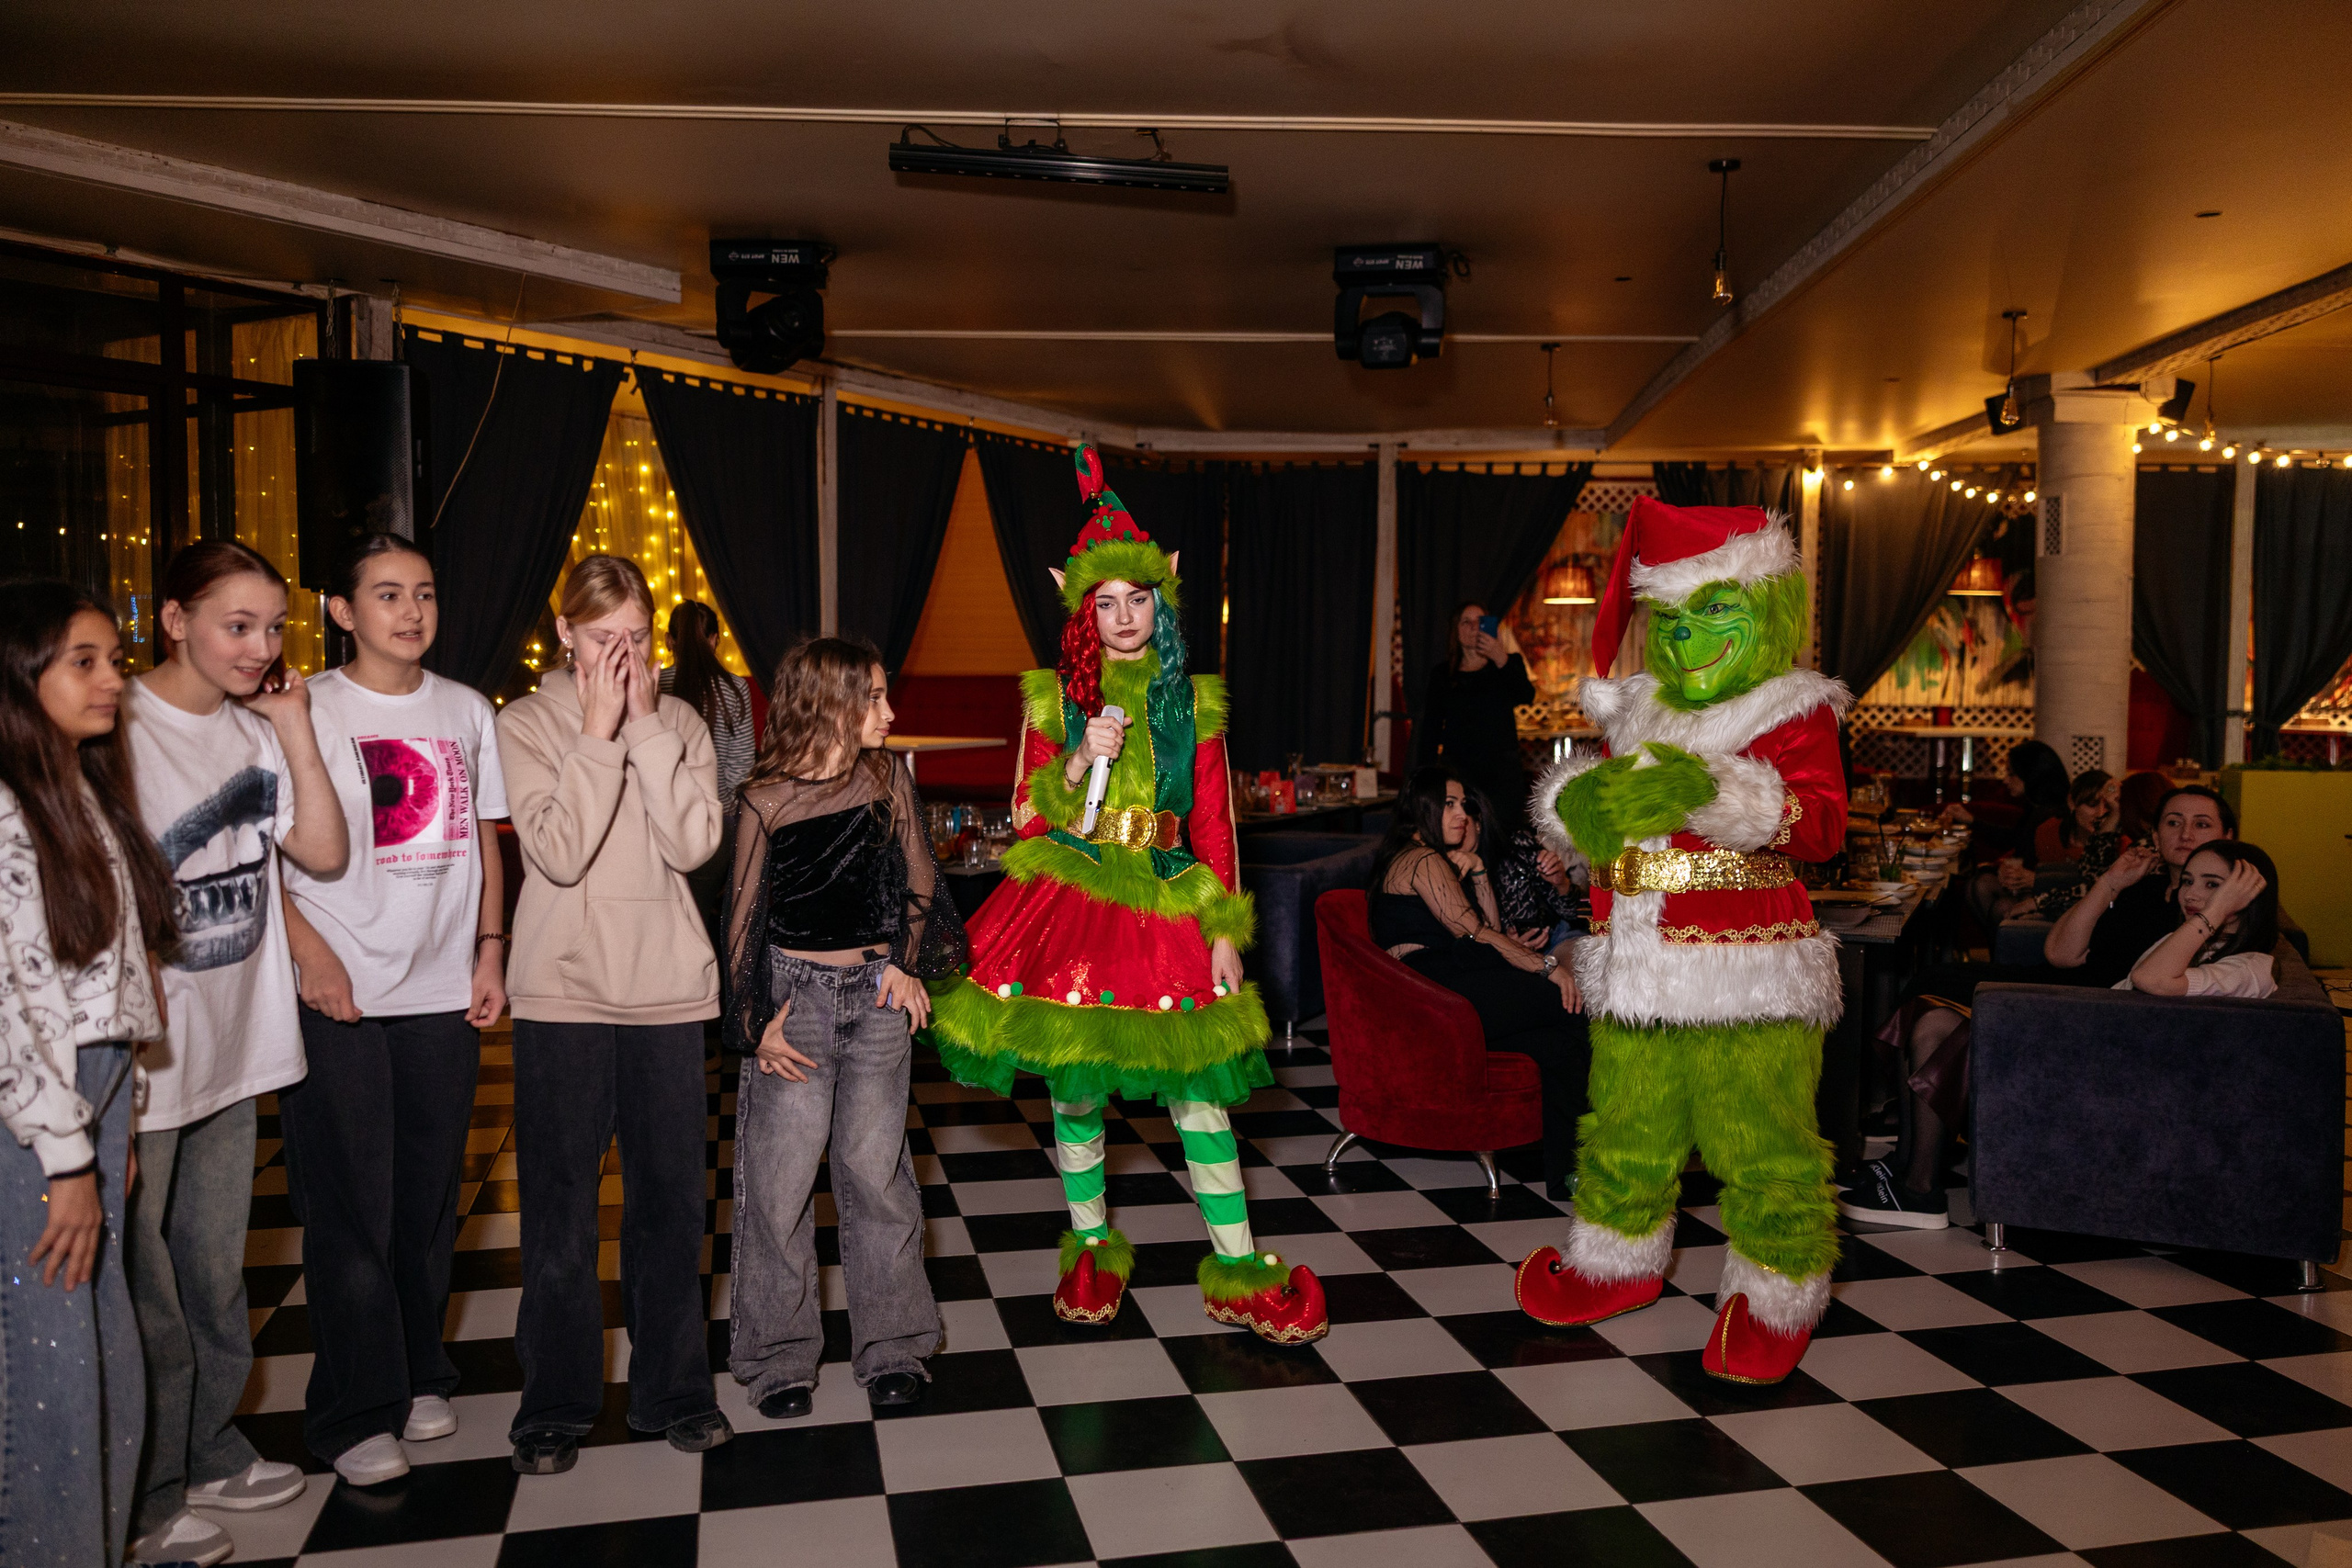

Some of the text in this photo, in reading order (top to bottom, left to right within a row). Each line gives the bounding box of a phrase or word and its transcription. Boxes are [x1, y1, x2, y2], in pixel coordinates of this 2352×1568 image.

[771, 254, 800, 264] WEN
[1395, 260, 1424, 270] WEN
[449, 740, 464, 766] MOON
[444, 757, 454, 776] Times
[458, 769, 468, 783] ON
[447, 776, 457, 793] York
[447, 794, 456, 807] New
[459, 785, 469, 815] WALK
[459, 818, 469, 840] MEN
[375, 854, 399, 865] road
[401, 852, 413, 863] to
